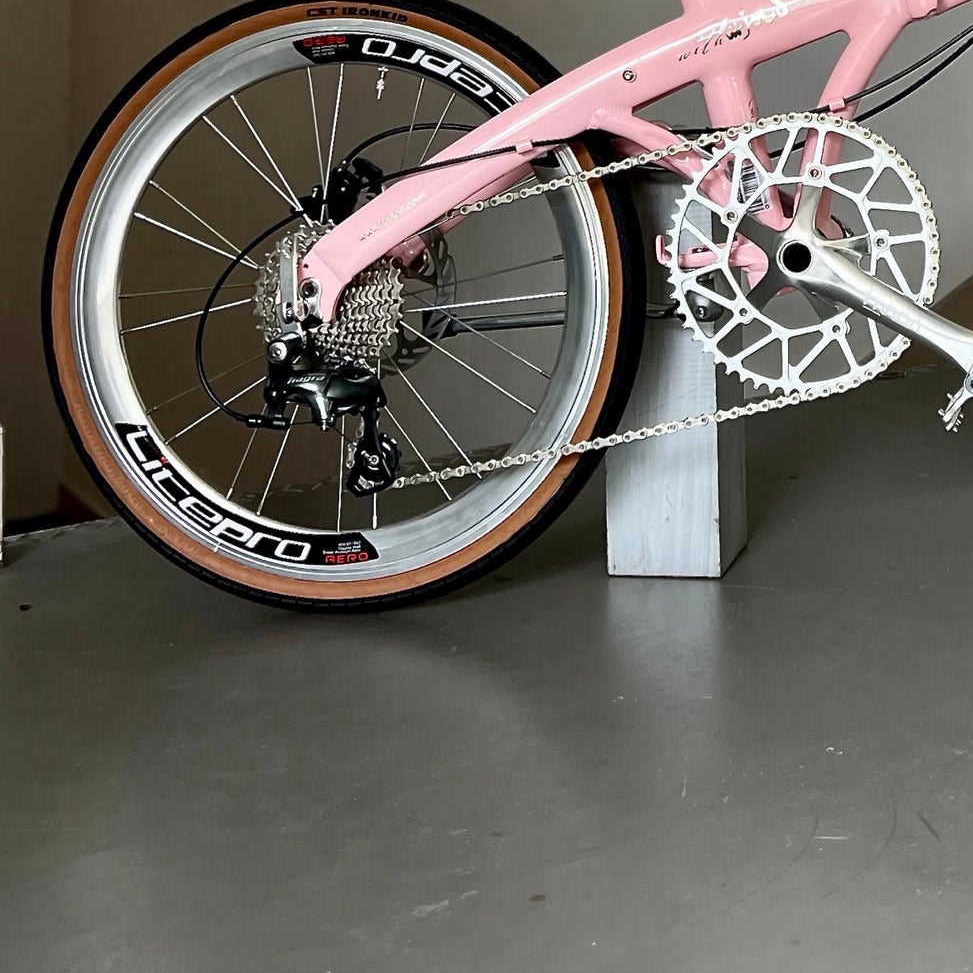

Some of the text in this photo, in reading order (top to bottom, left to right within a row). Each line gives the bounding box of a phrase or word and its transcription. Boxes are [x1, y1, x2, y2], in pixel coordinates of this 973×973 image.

[306, 6, 408, 23] CST IRONKID
[324, 552, 369, 565] AERO
